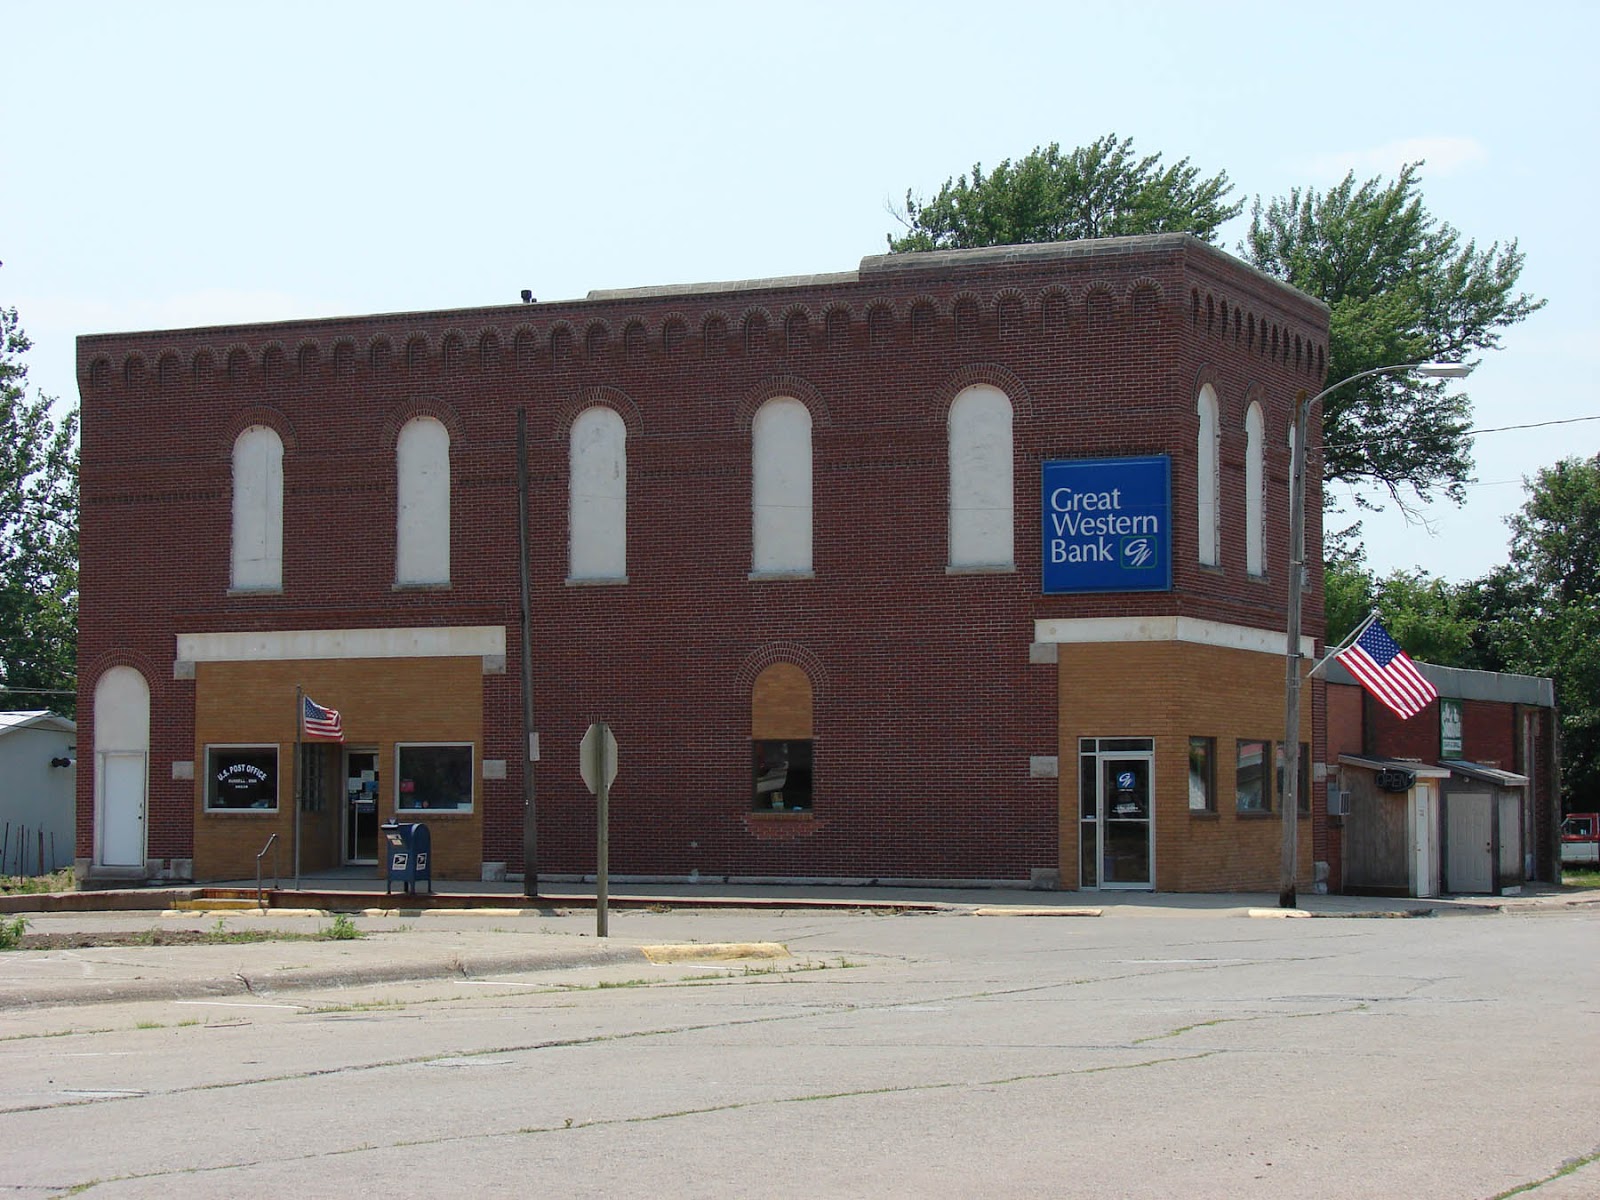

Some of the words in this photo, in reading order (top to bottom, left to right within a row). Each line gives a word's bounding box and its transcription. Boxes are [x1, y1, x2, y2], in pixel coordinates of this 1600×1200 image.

[1051, 487, 1121, 512] Great
[1051, 512, 1158, 536] Western
[1051, 536, 1113, 563] Bank
[217, 769, 229, 781] U.S.
[229, 763, 246, 774] POST
[246, 764, 268, 781] OFFICE
[1376, 773, 1409, 787] OPEN
